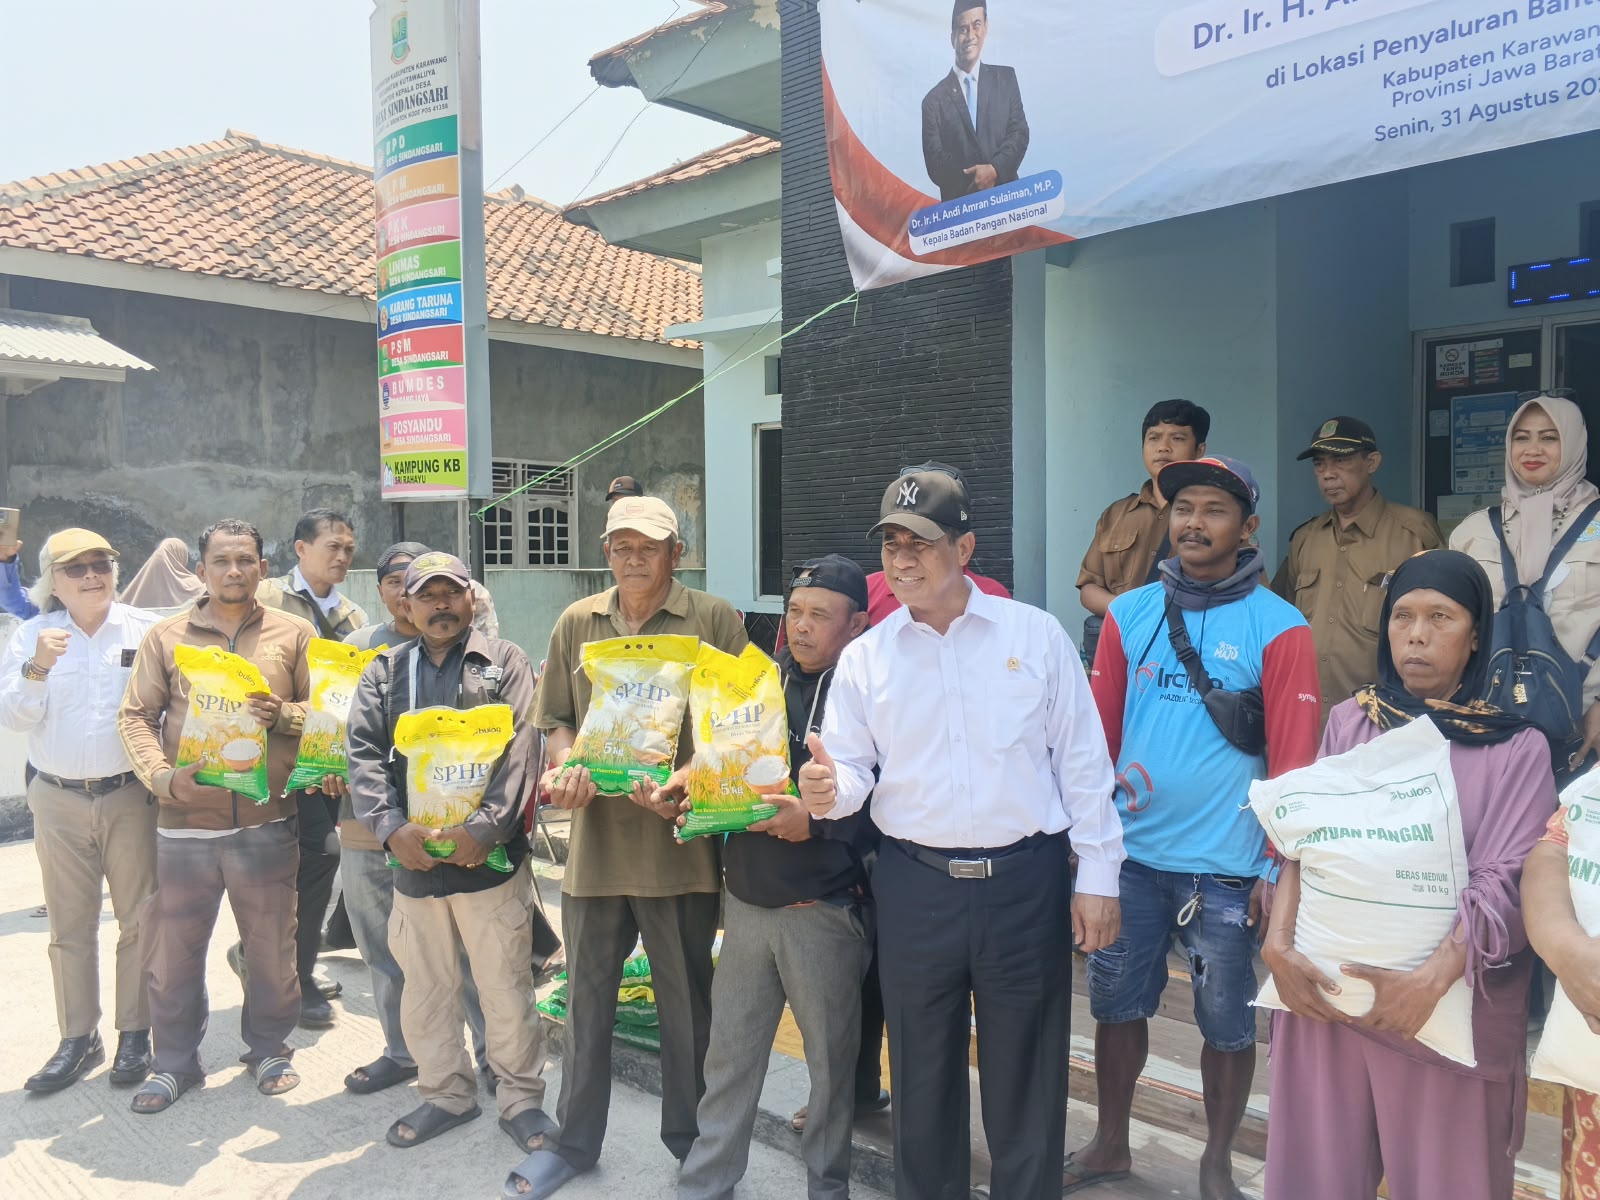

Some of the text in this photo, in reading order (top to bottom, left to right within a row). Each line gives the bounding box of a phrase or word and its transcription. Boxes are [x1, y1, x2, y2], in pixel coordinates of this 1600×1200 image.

[1194, 22, 1233, 49] Dr.
[1243, 8, 1271, 35] Ir.
[1266, 65, 1286, 88] di
[1293, 44, 1365, 82] Lokasi
[1373, 9, 1518, 60] Penyaluran
[415, 55, 448, 71] KARAWANG
[1383, 51, 1494, 89] Kabupaten
[395, 85, 414, 98] KEPALA
[415, 80, 432, 91] DESA
[1392, 73, 1472, 108] Provinsi
[1478, 62, 1536, 87] Jawa
[388, 85, 449, 117] SINDANGSARI
[421, 106, 431, 115] POS
[1375, 76, 1600, 142] Senin, 31 Agustus 20
[399, 142, 443, 162] SINDANGSARI
[911, 218, 923, 229] Dr.
[932, 212, 941, 223] H.
[942, 205, 961, 220] Andi
[962, 199, 989, 214] Amran
[990, 188, 1032, 207] Sulaiman,
[1033, 179, 1054, 195] M.P.
[922, 204, 1048, 247] Kepala Badan Pangan Nasional
[388, 255, 420, 276] LINMAS
[401, 267, 446, 283] SINDANGSARI
[389, 293, 453, 315] KARANG TARUNA
[390, 307, 448, 326] DESA SINDANGSARI
[402, 350, 449, 365] SINDANGSARI
[393, 417, 443, 436] POSYANDU
[406, 432, 451, 446] SINDANGSARI
[394, 458, 461, 475] KAMPUNG KB
[403, 474, 427, 484] RAHAYU
[615, 682, 671, 701] SPHP
[604, 742, 613, 754] 5
[433, 762, 490, 782] SPHP
[721, 783, 730, 795] 5
[1396, 786, 1433, 800] bulog
[1366, 823, 1434, 843] PANGAN
[1395, 869, 1448, 883] BERAS MEDIUM
[1427, 884, 1437, 894] 10
[1438, 885, 1449, 896] kg
